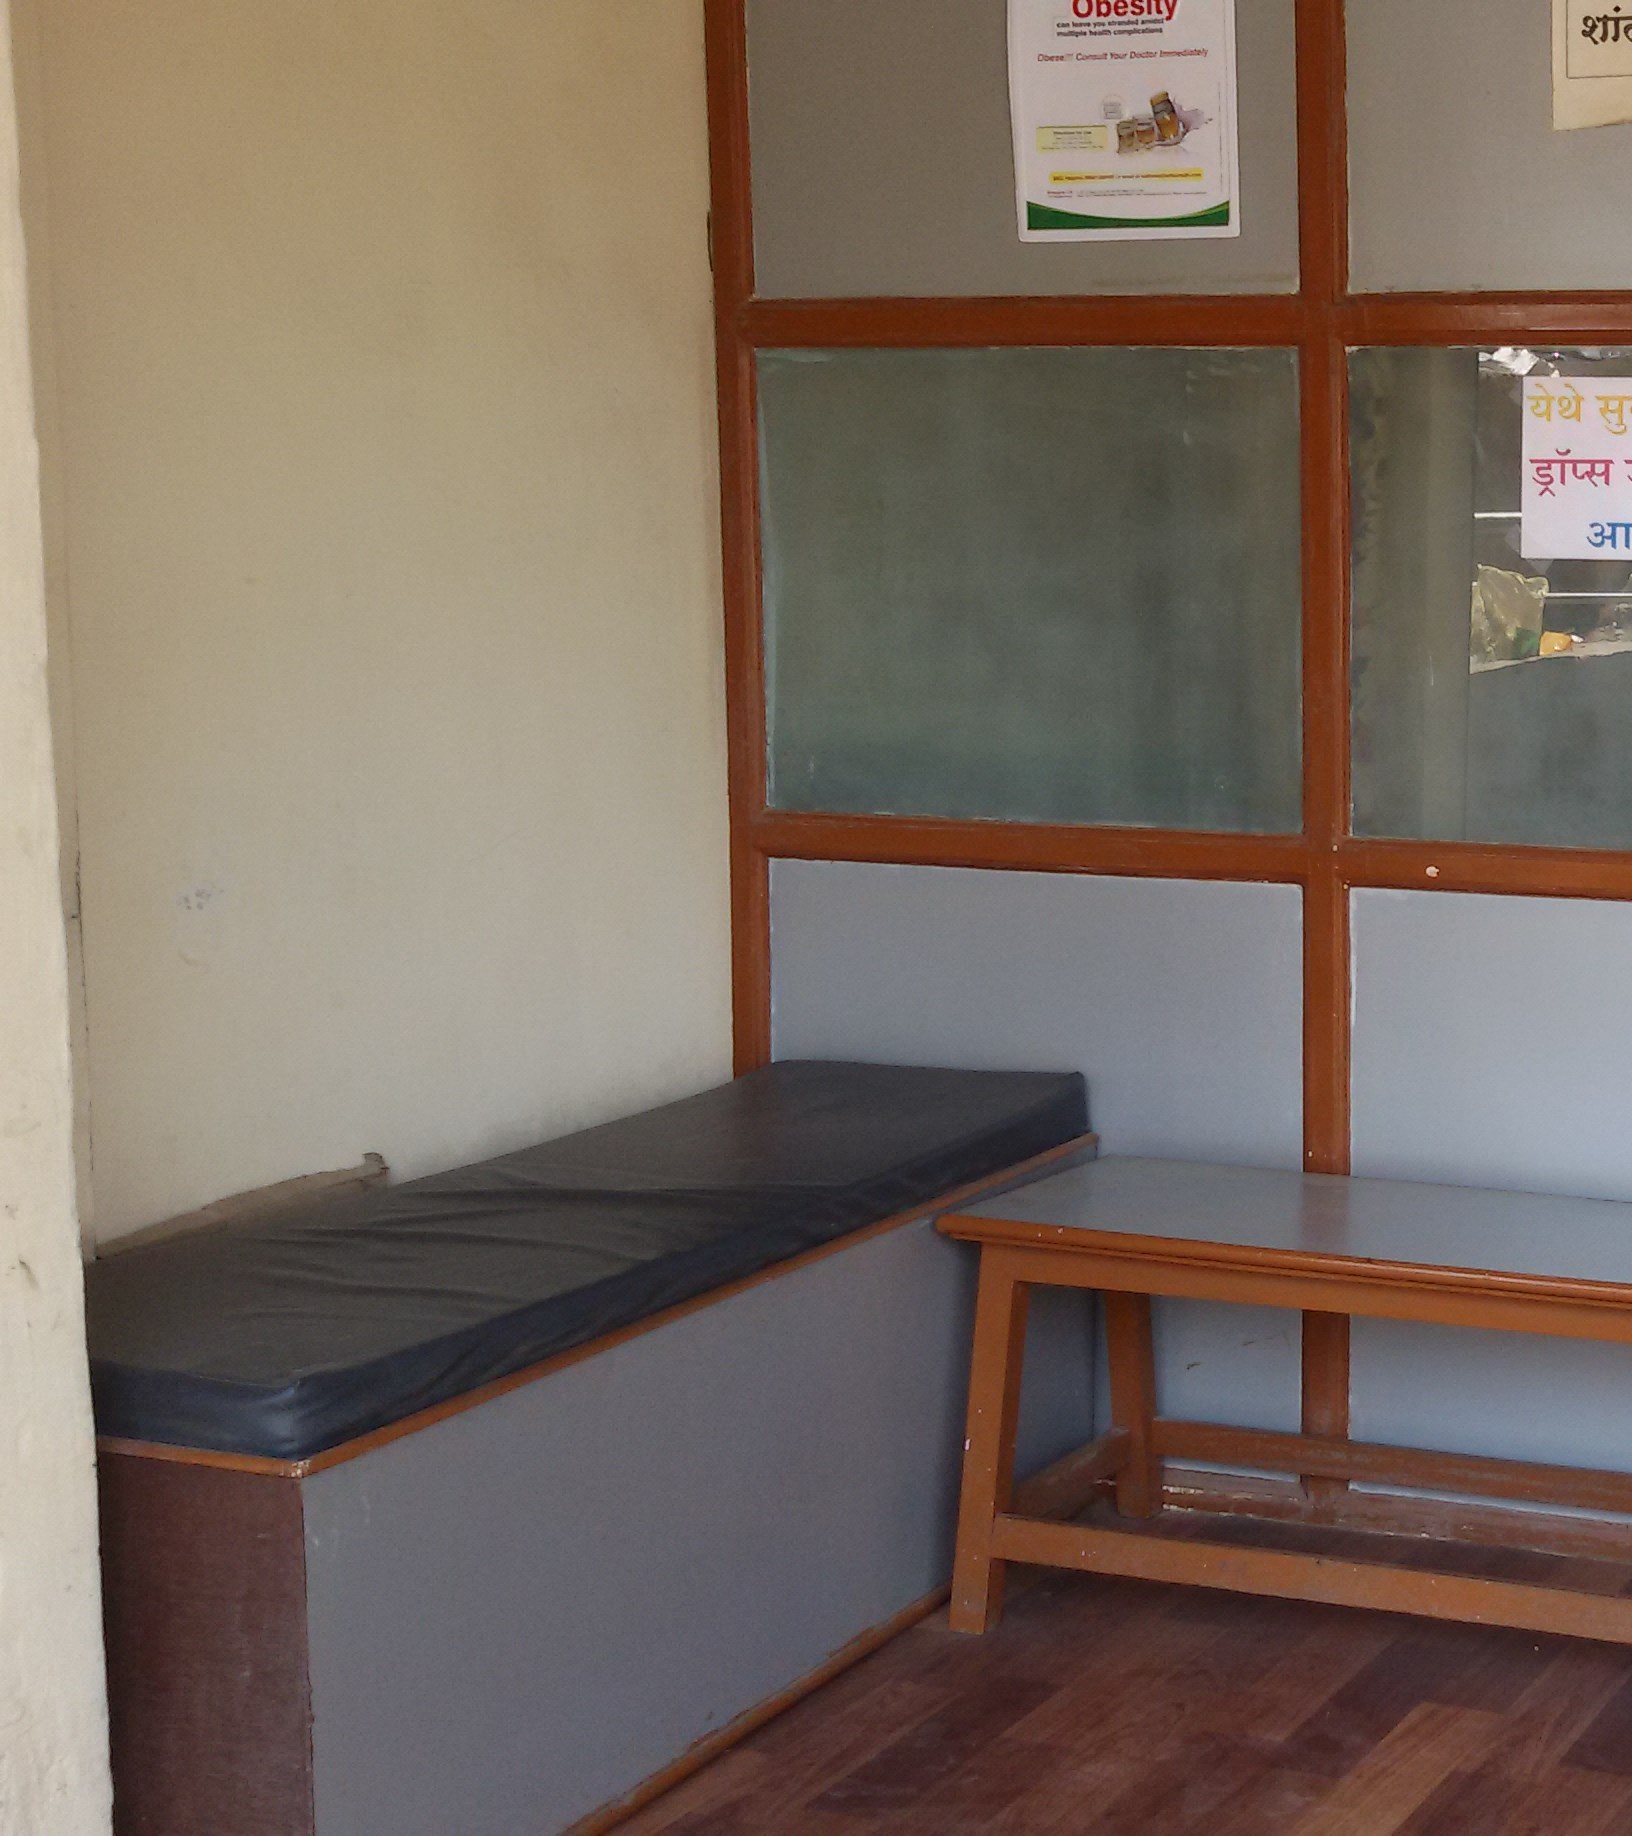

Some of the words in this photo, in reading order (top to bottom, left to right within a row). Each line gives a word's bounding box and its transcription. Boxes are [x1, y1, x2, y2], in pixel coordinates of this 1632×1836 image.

[1072, 0, 1179, 21] Obesity
[1130, 51, 1157, 59] Doctor
[1526, 383, 1585, 422] येथे
[1529, 448, 1614, 497] ड्रॉप्स
